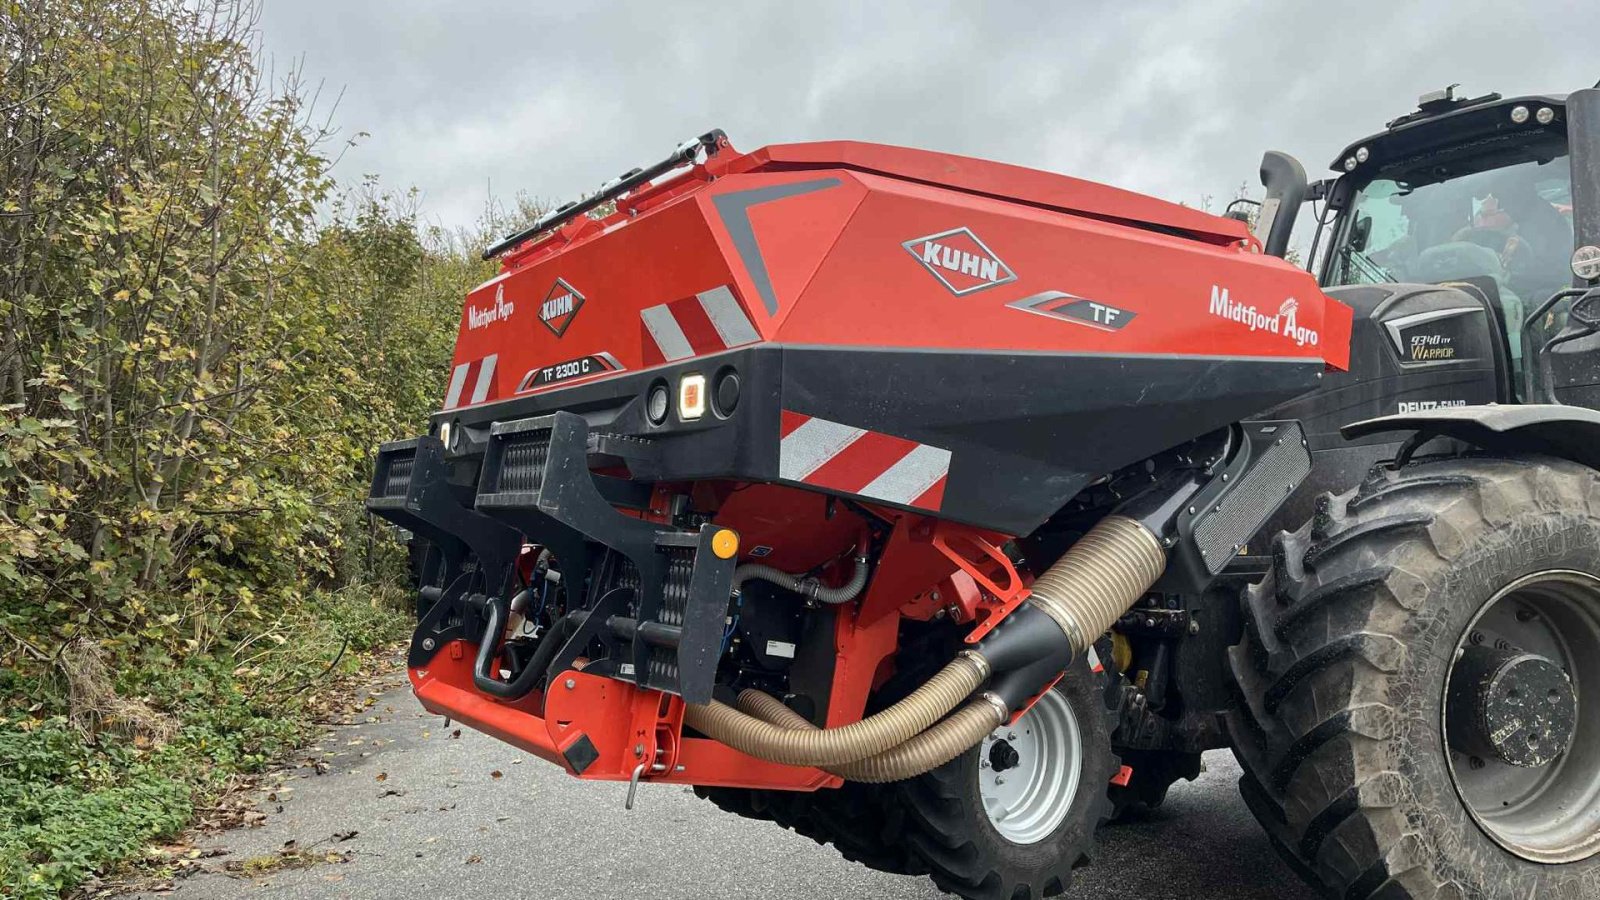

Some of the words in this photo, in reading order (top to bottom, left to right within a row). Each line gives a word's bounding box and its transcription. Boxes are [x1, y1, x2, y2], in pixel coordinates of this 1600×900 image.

[923, 241, 999, 282] KUHN
[468, 304, 497, 331] Midtfjord
[497, 290, 514, 321] Agro
[542, 292, 573, 321] KUHN
[1089, 303, 1121, 325] TF
[1209, 284, 1280, 334] Midtfjord
[1282, 304, 1318, 346] Agro
[1411, 334, 1440, 346] 9340
[1411, 344, 1454, 360] WARRIOR
[542, 368, 554, 382] TF
[555, 361, 580, 379] 2300
[581, 359, 590, 373] C
